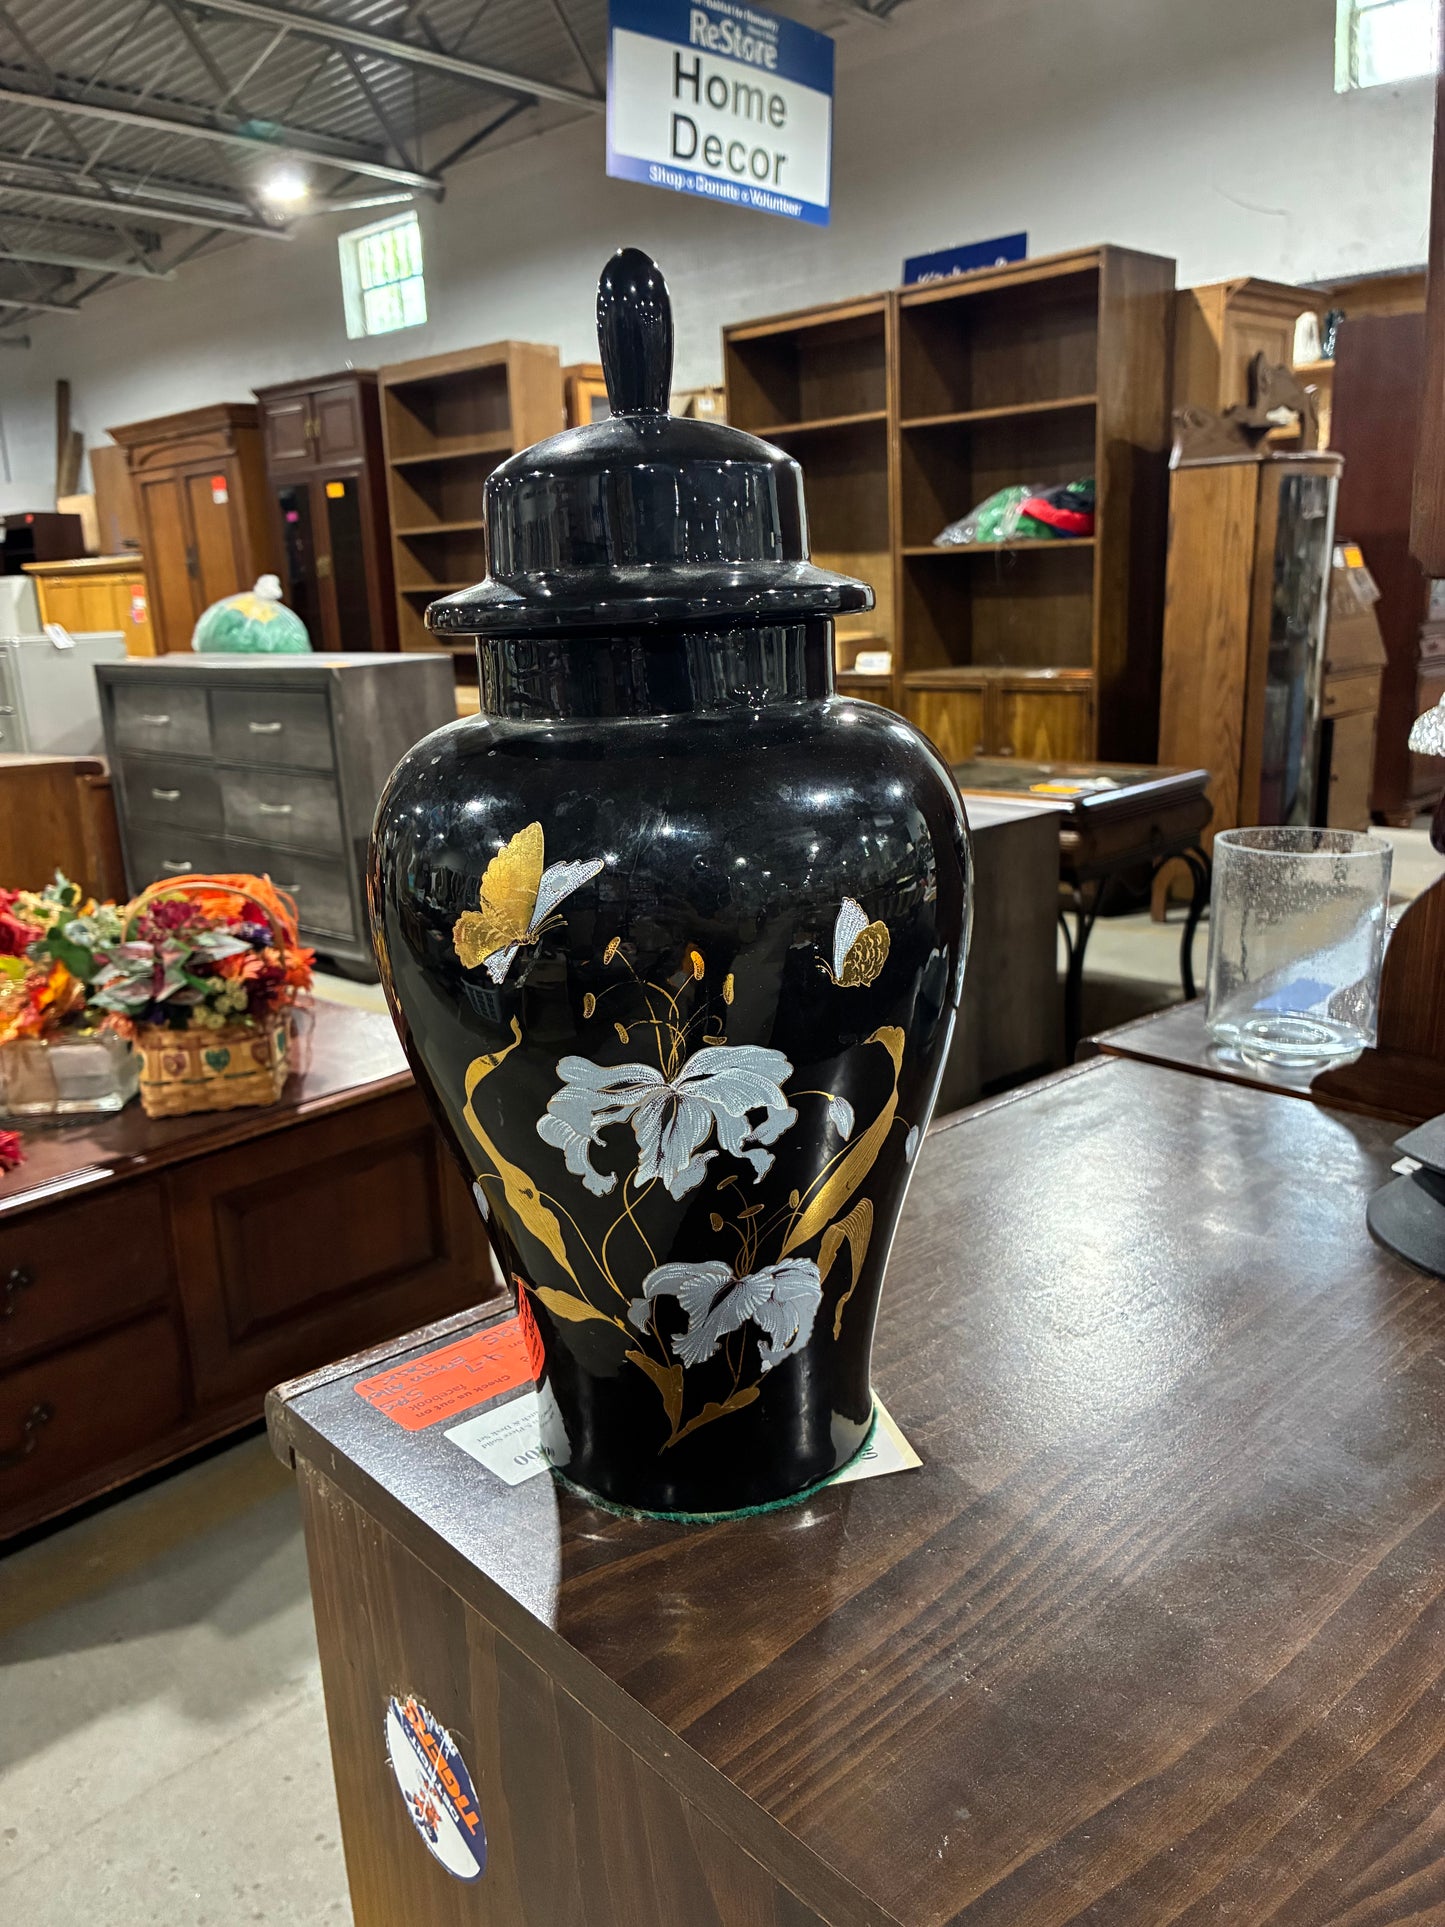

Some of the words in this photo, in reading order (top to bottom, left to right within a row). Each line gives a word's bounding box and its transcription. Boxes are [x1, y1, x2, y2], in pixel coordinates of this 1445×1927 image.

[689, 9, 778, 70] ReStore
[673, 51, 786, 128] Home
[672, 112, 786, 186] Decor
[649, 165, 685, 191] Shop
[750, 188, 803, 217] Volunteer
[409, 1383, 467, 1411] facebook
[433, 1397, 456, 1410] out
[456, 1390, 472, 1400] us
[472, 1373, 511, 1393] Check
[414, 1408, 432, 1418] on
[403, 1698, 480, 1836] TIGERS
[407, 1732, 460, 1823] DETROIT
